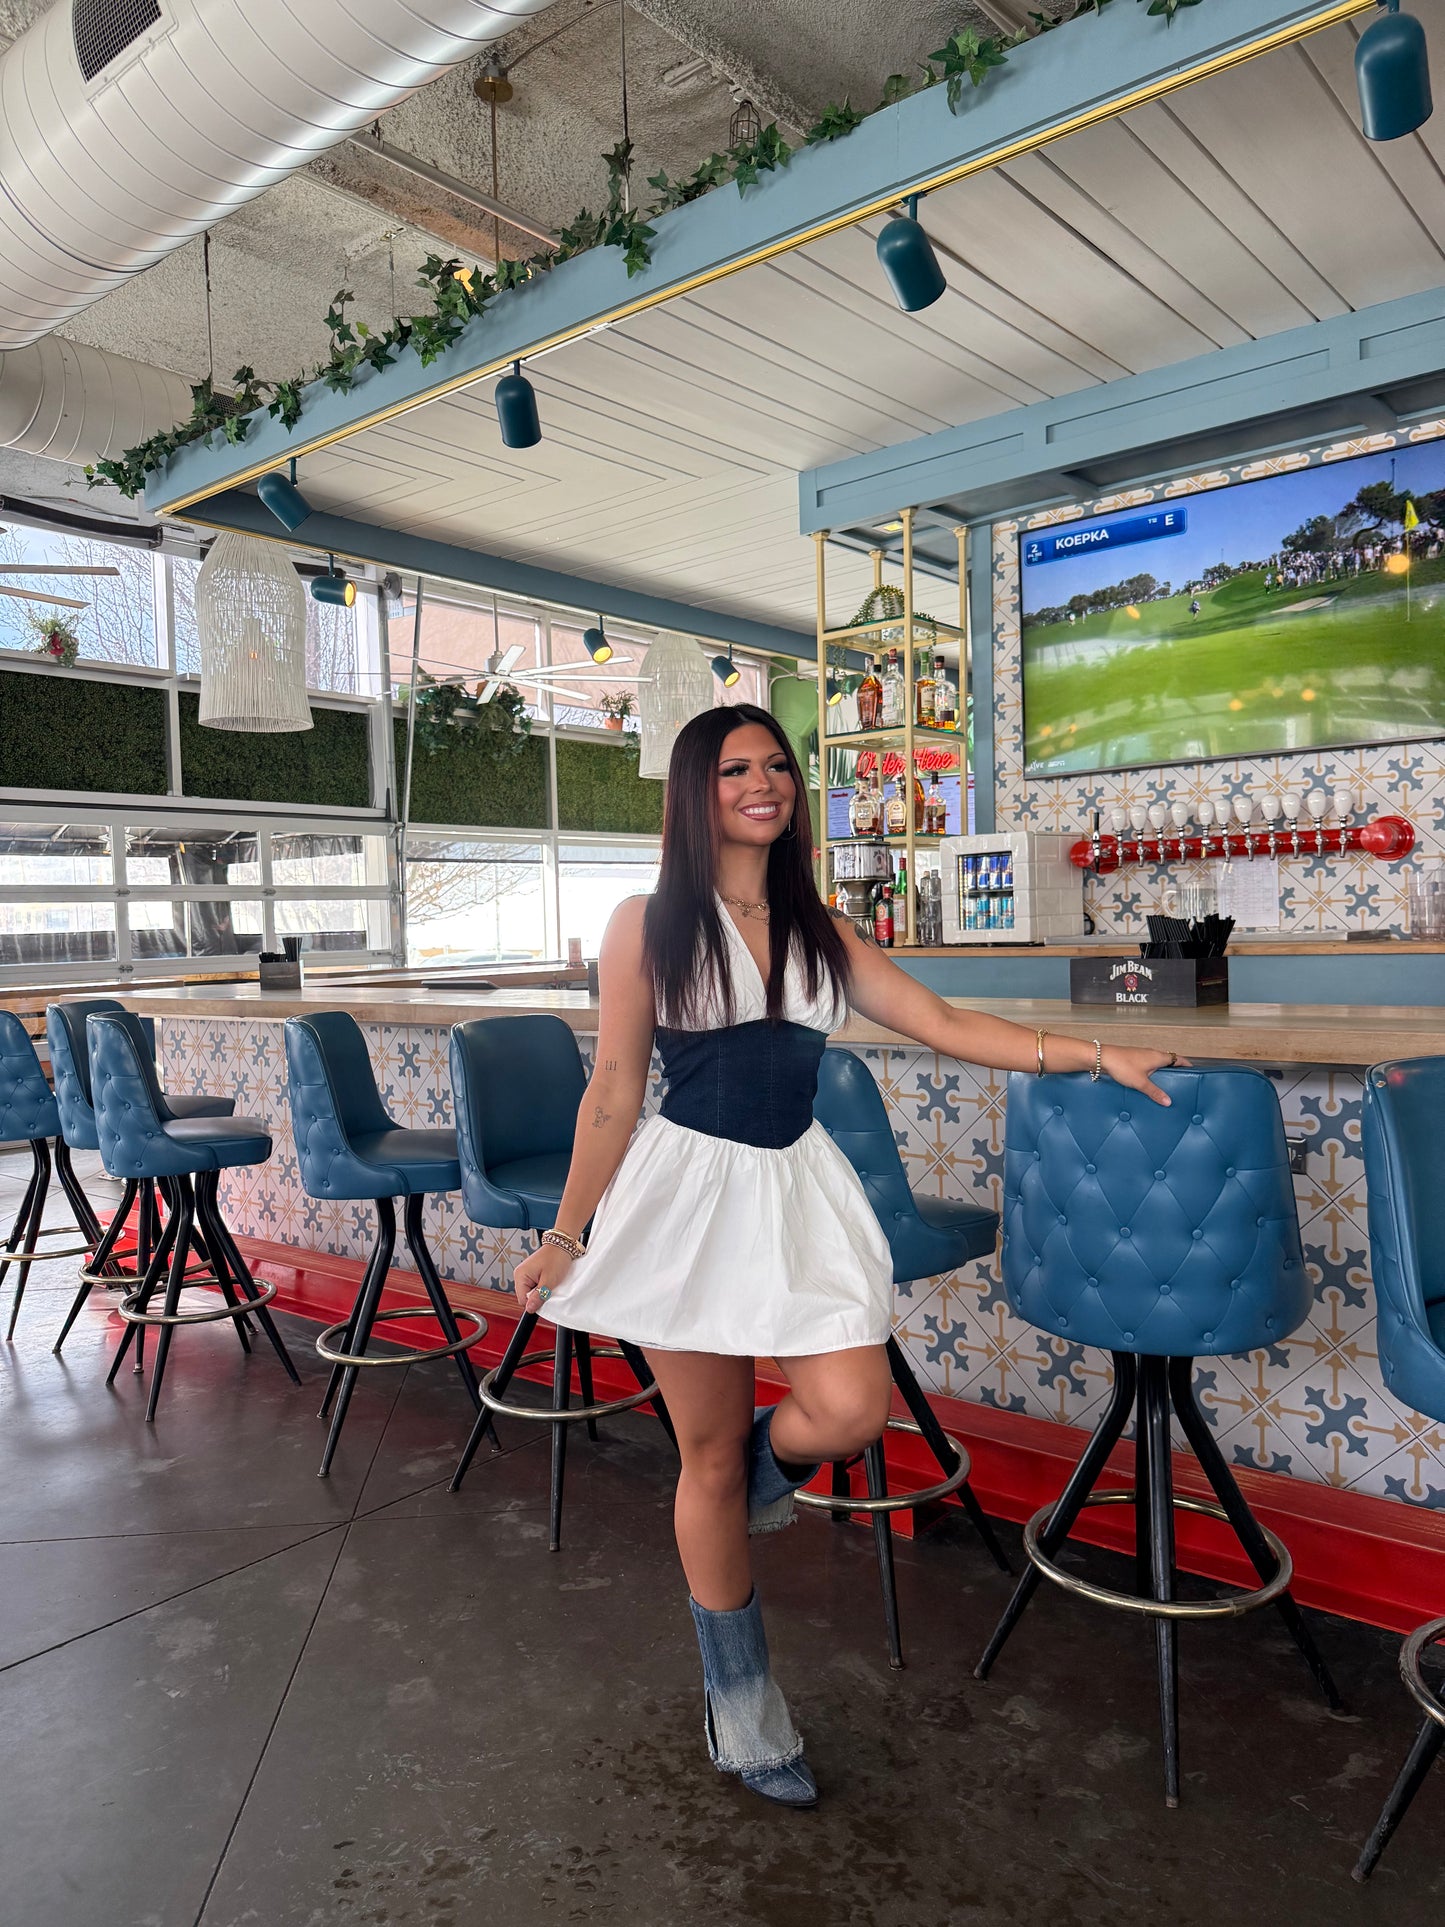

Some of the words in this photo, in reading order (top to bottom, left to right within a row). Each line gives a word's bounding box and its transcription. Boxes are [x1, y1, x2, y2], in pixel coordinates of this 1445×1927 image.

[1165, 514, 1174, 526] E
[1055, 528, 1110, 550] KOEPKA
[1031, 544, 1039, 553] 2
[1109, 963, 1127, 981] JIM
[1127, 960, 1153, 981] BEAM
[1115, 992, 1148, 1003] BLACK
